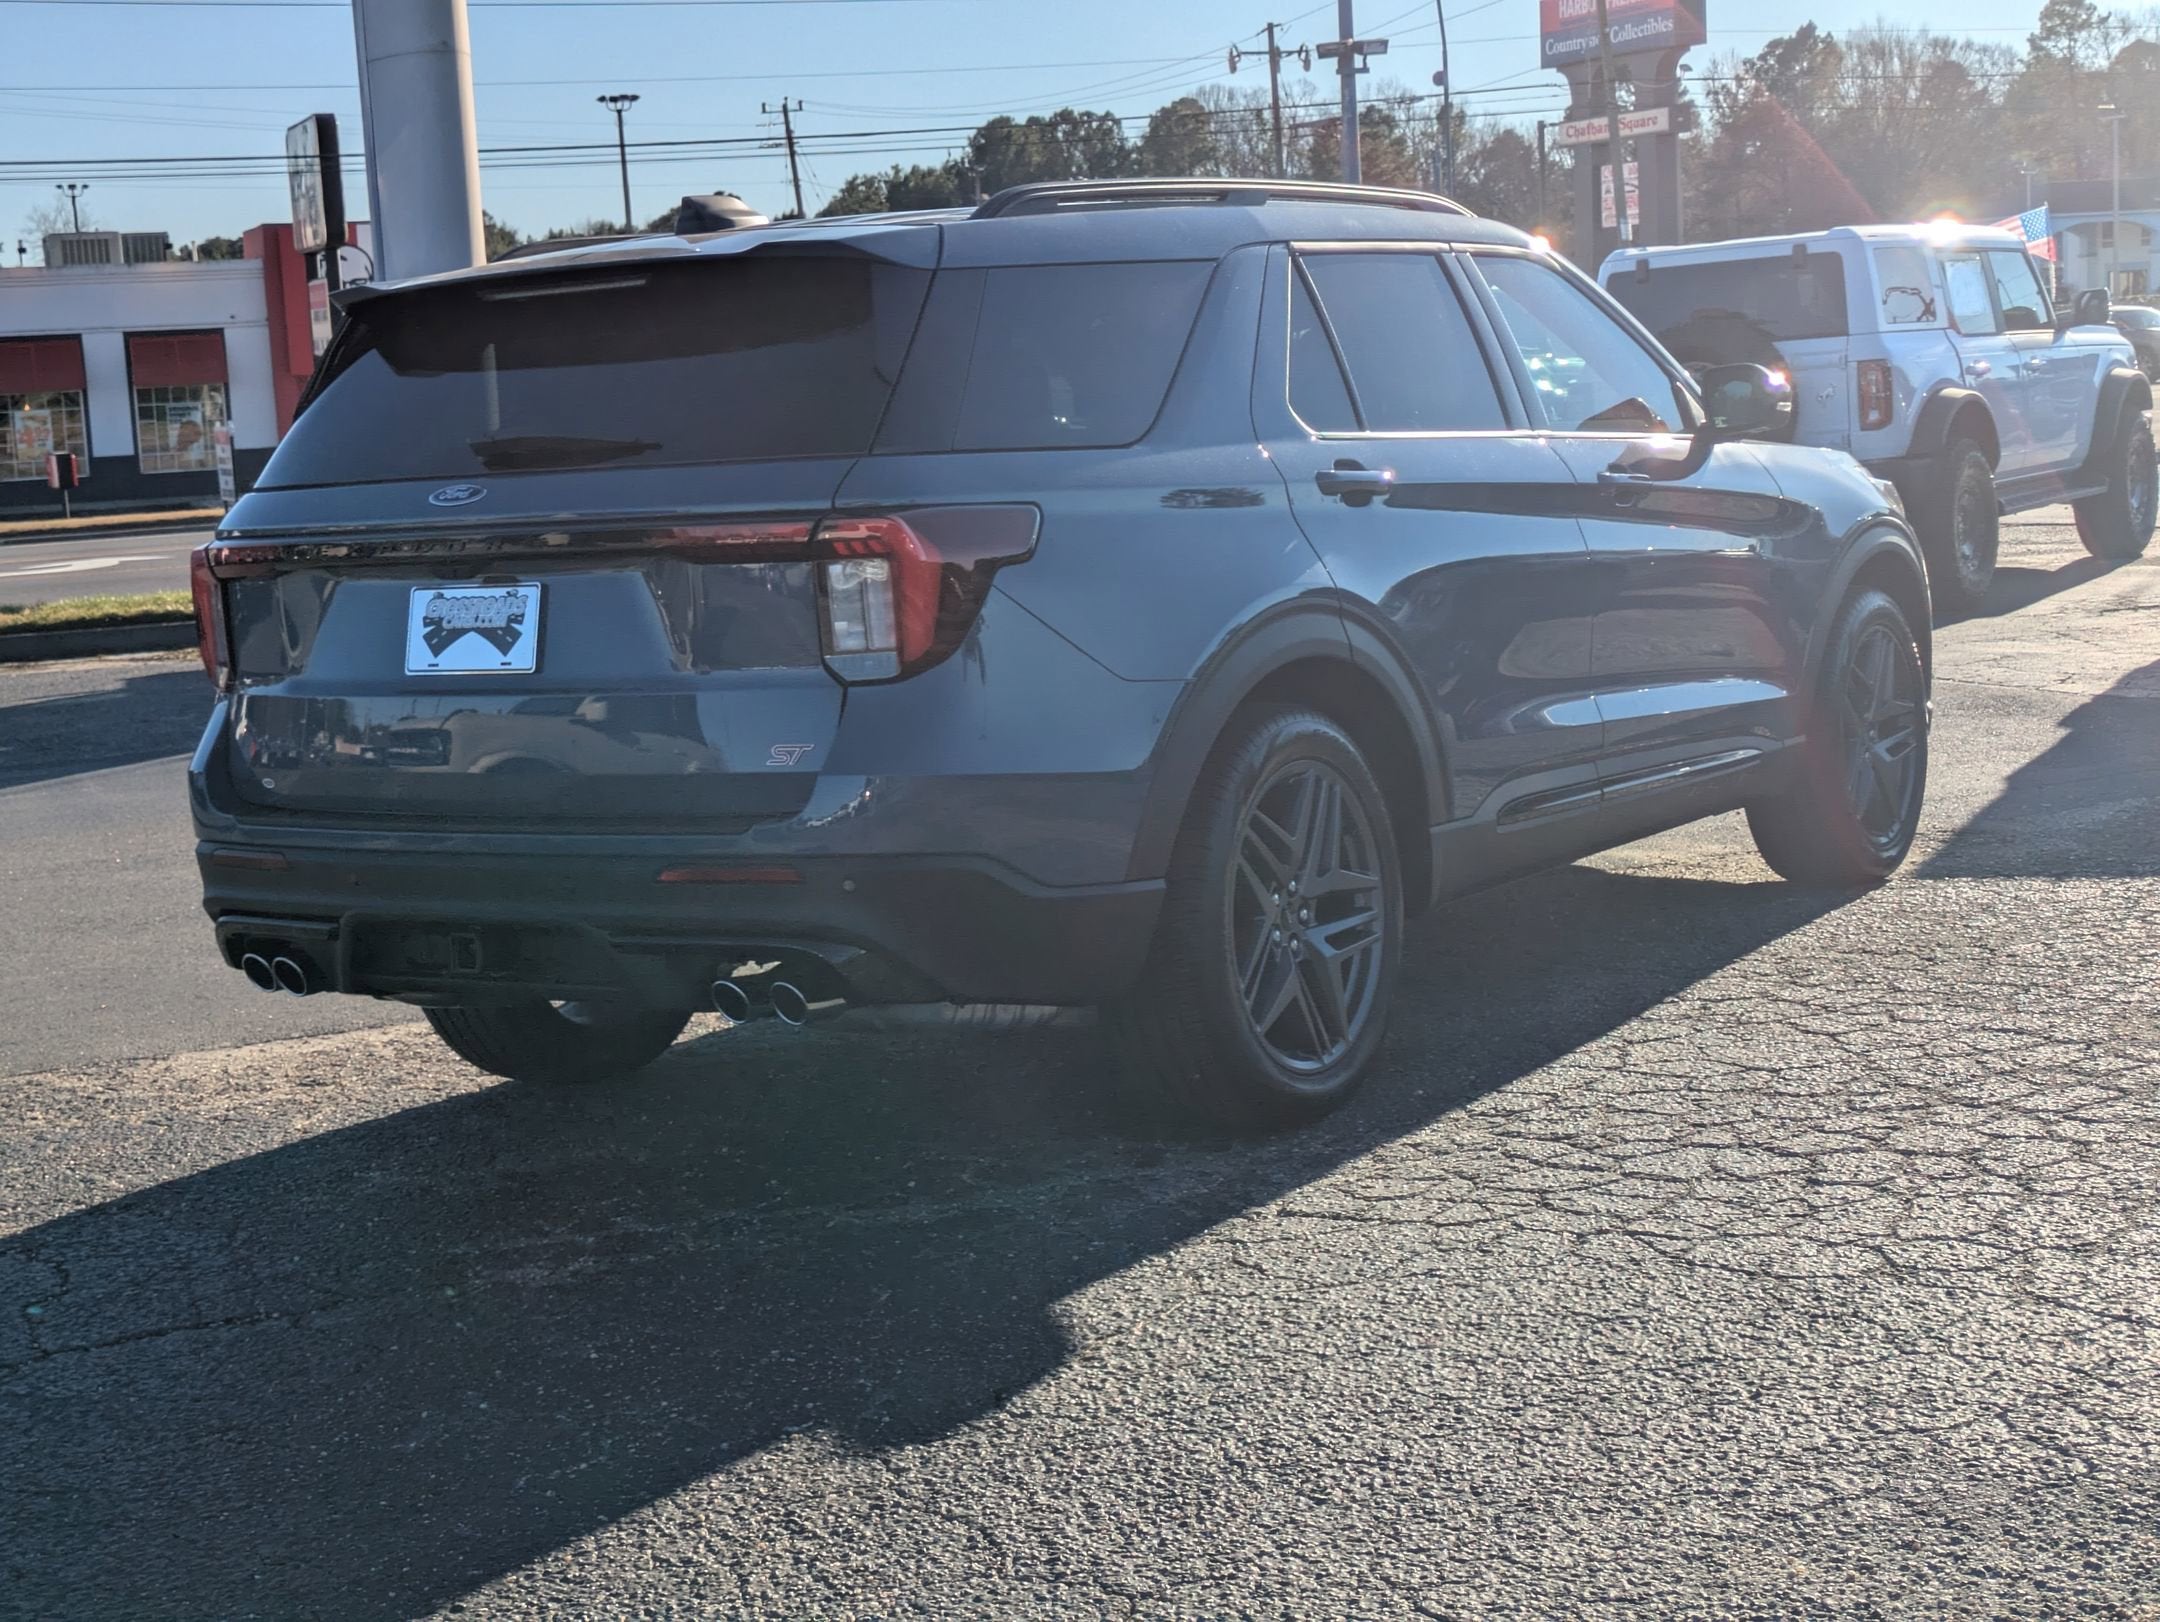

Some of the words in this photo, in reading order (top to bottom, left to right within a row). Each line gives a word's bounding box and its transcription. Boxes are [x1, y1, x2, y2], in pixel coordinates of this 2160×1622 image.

[1545, 37, 1588, 55] Country
[1609, 16, 1674, 44] Collectibles
[1618, 115, 1658, 133] Square
[766, 744, 815, 766] ST
